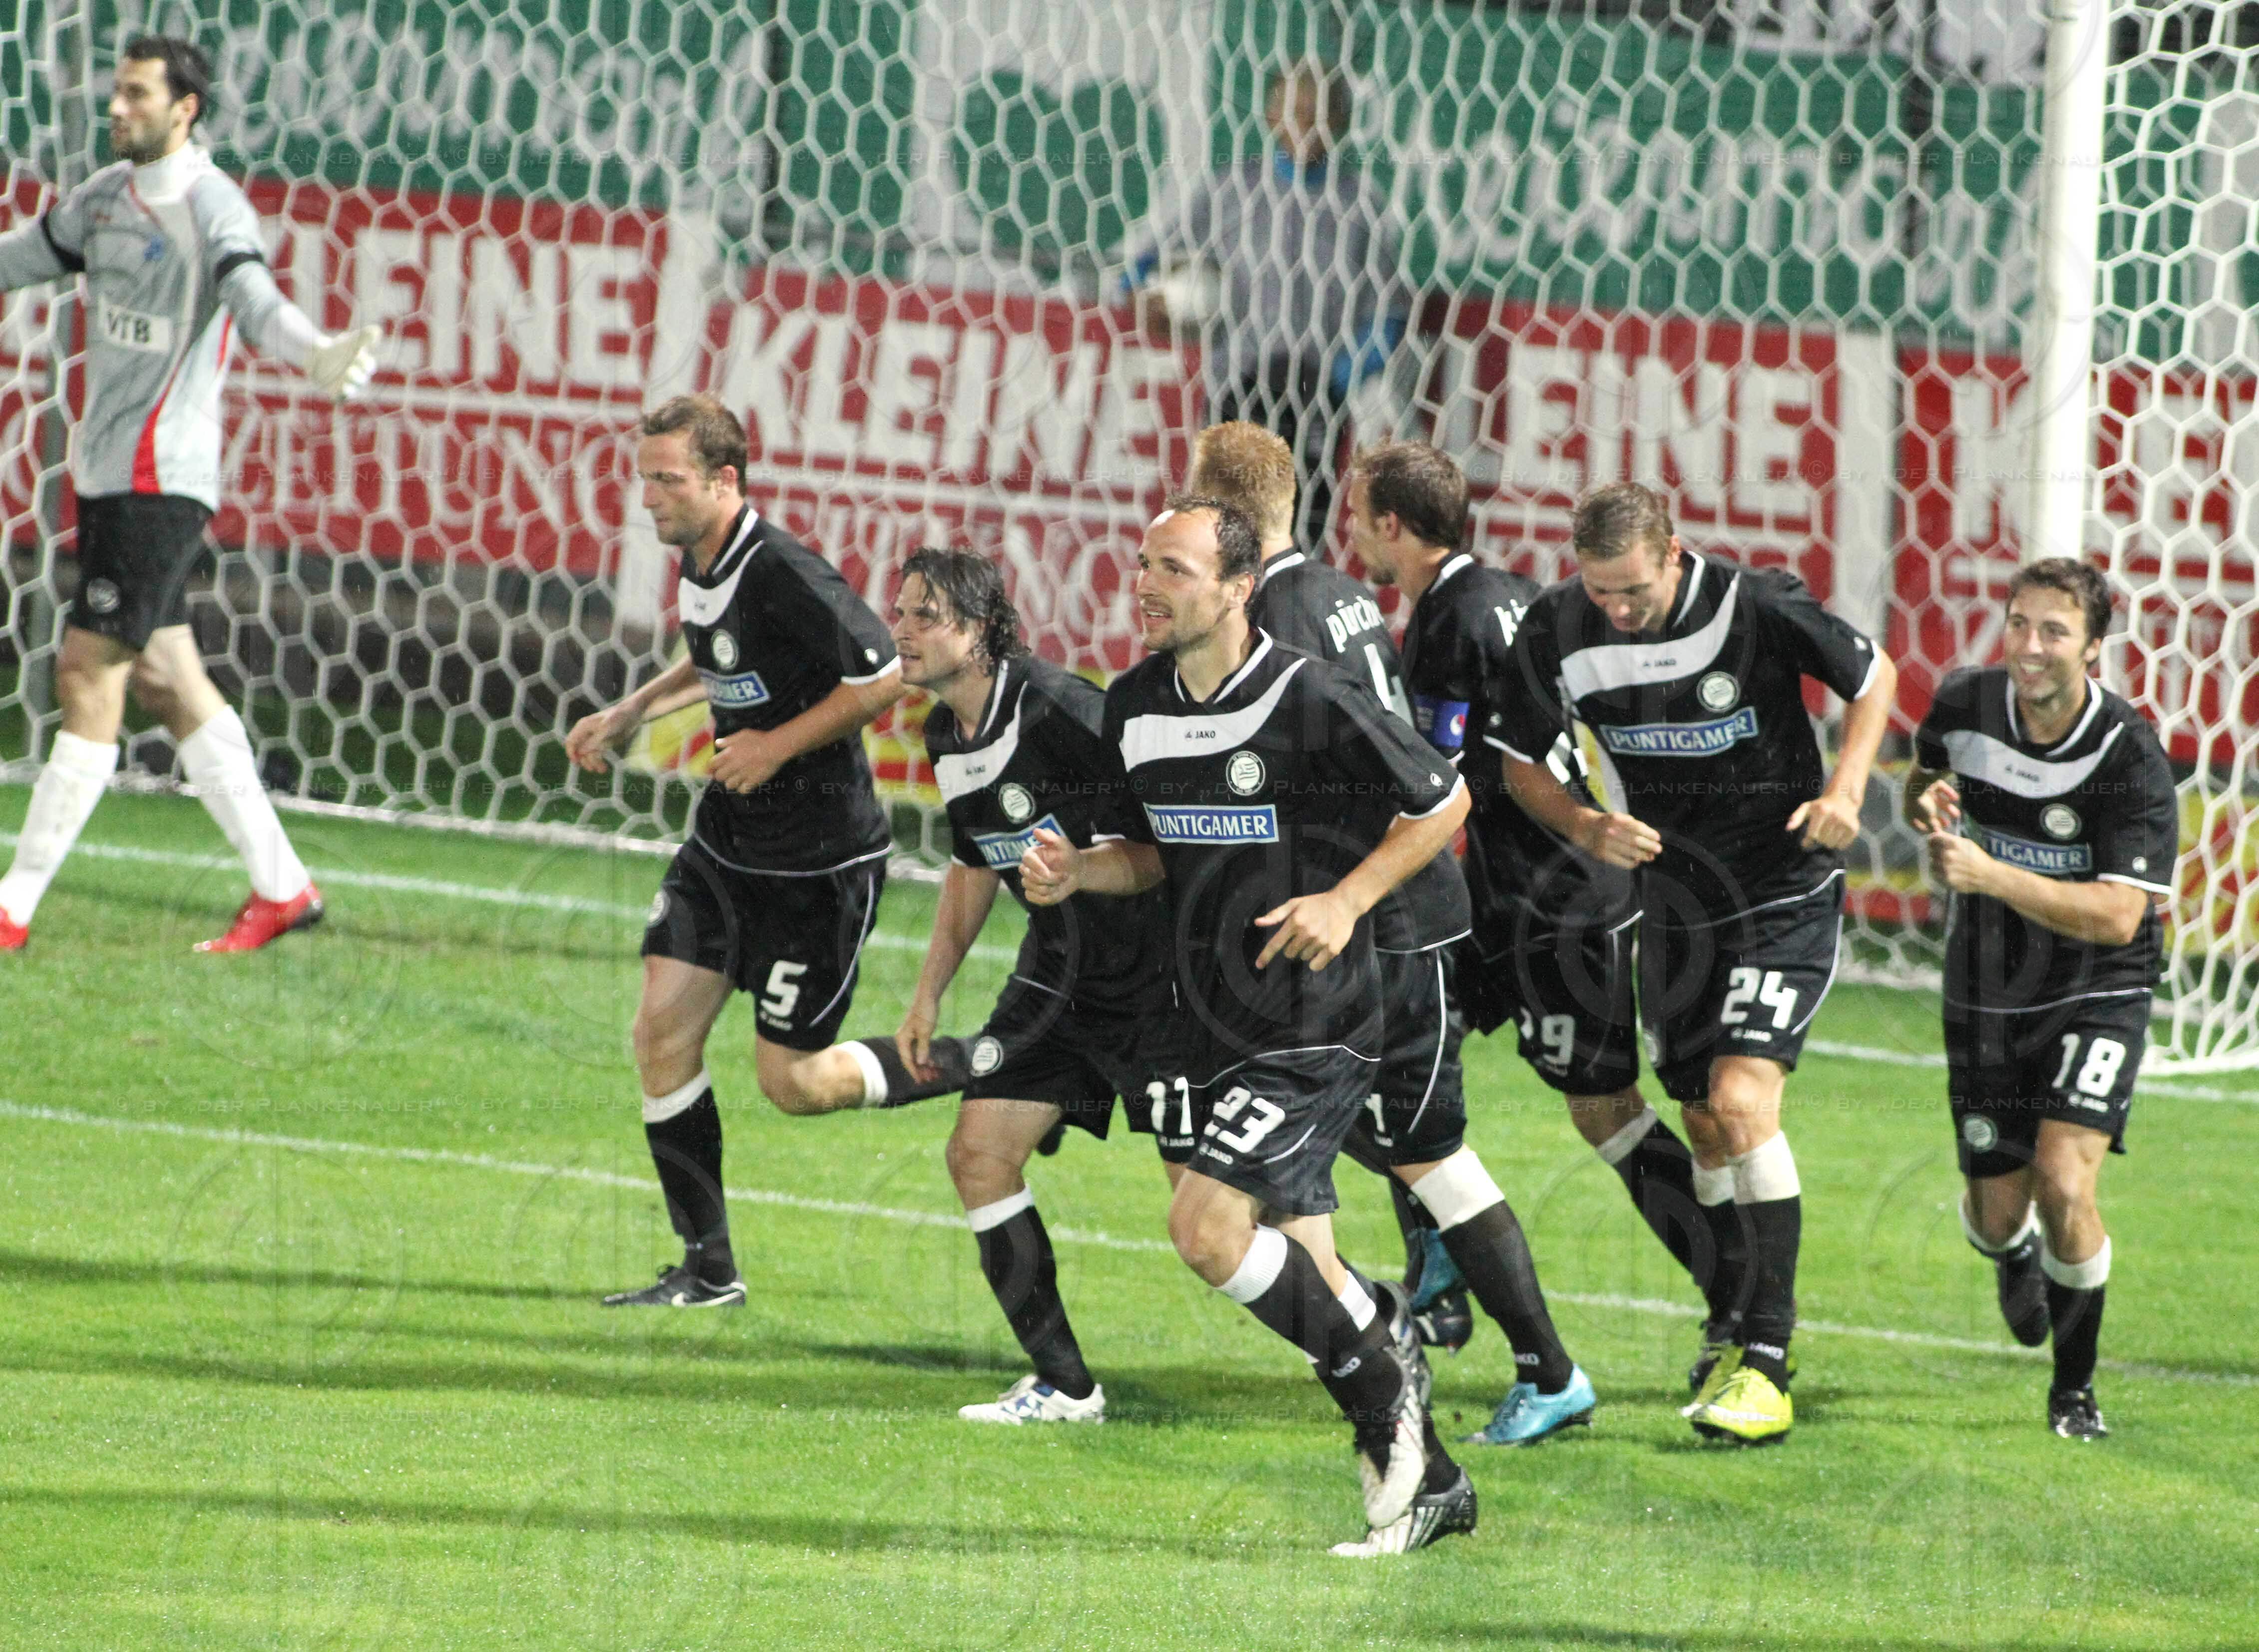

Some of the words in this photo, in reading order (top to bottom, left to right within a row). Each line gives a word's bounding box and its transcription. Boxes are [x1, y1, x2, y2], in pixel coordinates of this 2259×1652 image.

[106, 310, 151, 343] VTB
[723, 302, 1173, 487] KLEINE
[1195, 730, 1216, 739] JAKO
[1611, 716, 1748, 750] PUNTIGAMER
[760, 959, 807, 1017] 5
[1721, 967, 1798, 1029] 24
[2052, 1033, 2127, 1097] 18
[1146, 1076, 1193, 1135] 11
[1203, 1086, 1286, 1154] 23
